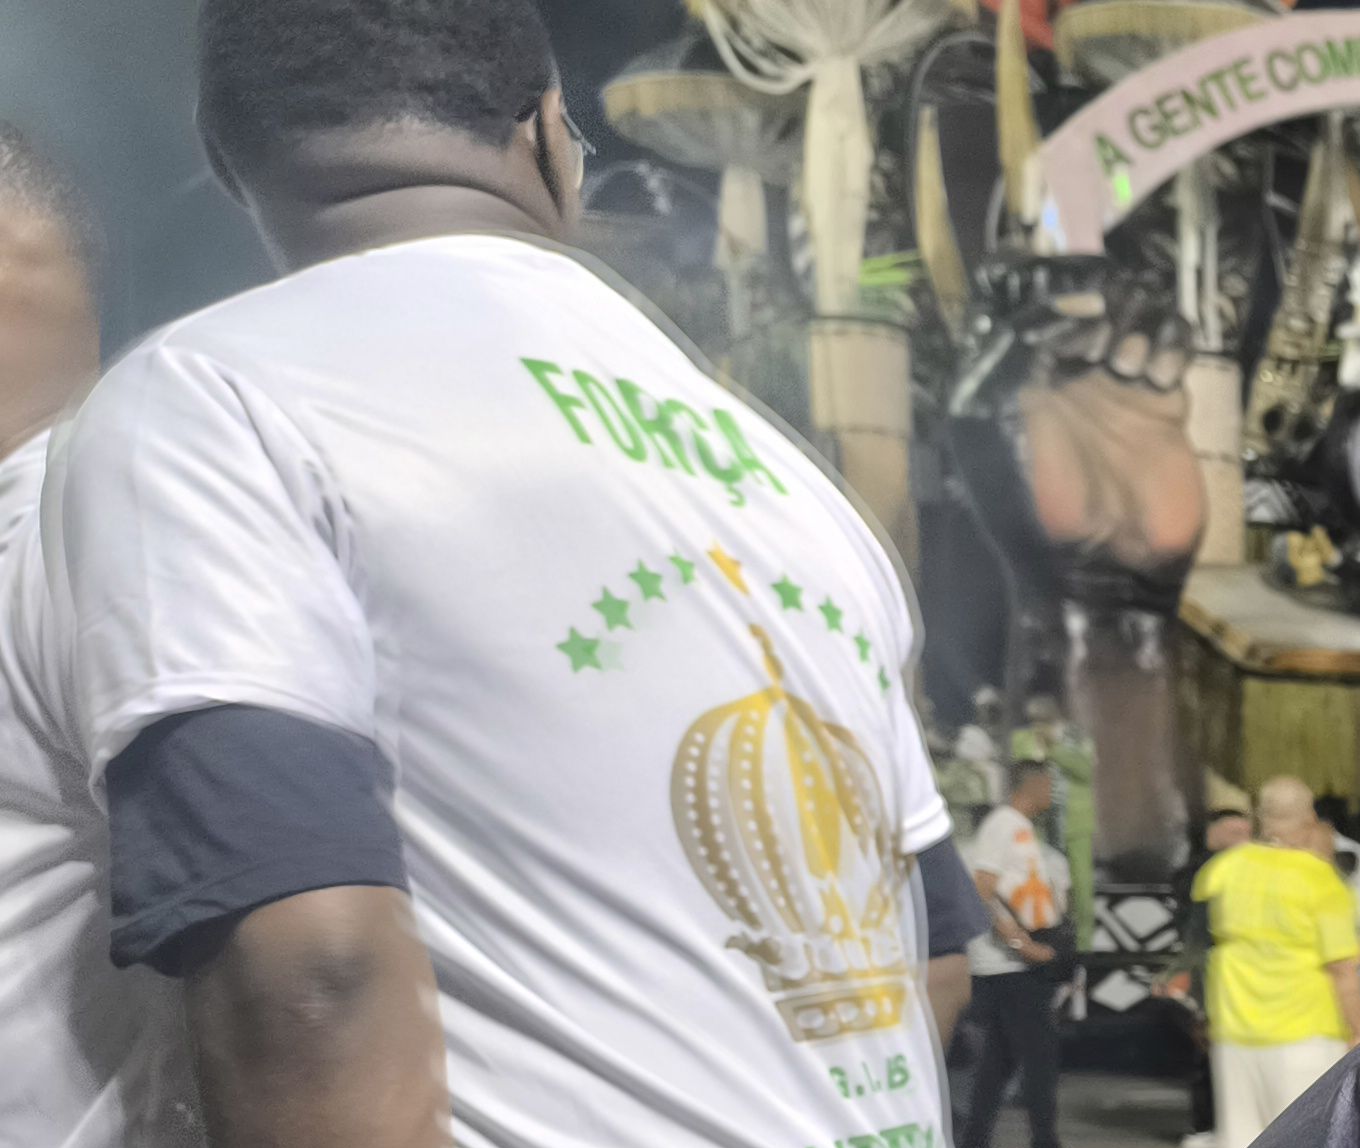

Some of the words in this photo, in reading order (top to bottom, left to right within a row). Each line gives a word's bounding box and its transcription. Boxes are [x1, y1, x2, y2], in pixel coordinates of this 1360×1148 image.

[1093, 131, 1133, 176] A
[1126, 54, 1267, 150] GENTE
[518, 357, 790, 508] FORÇA
